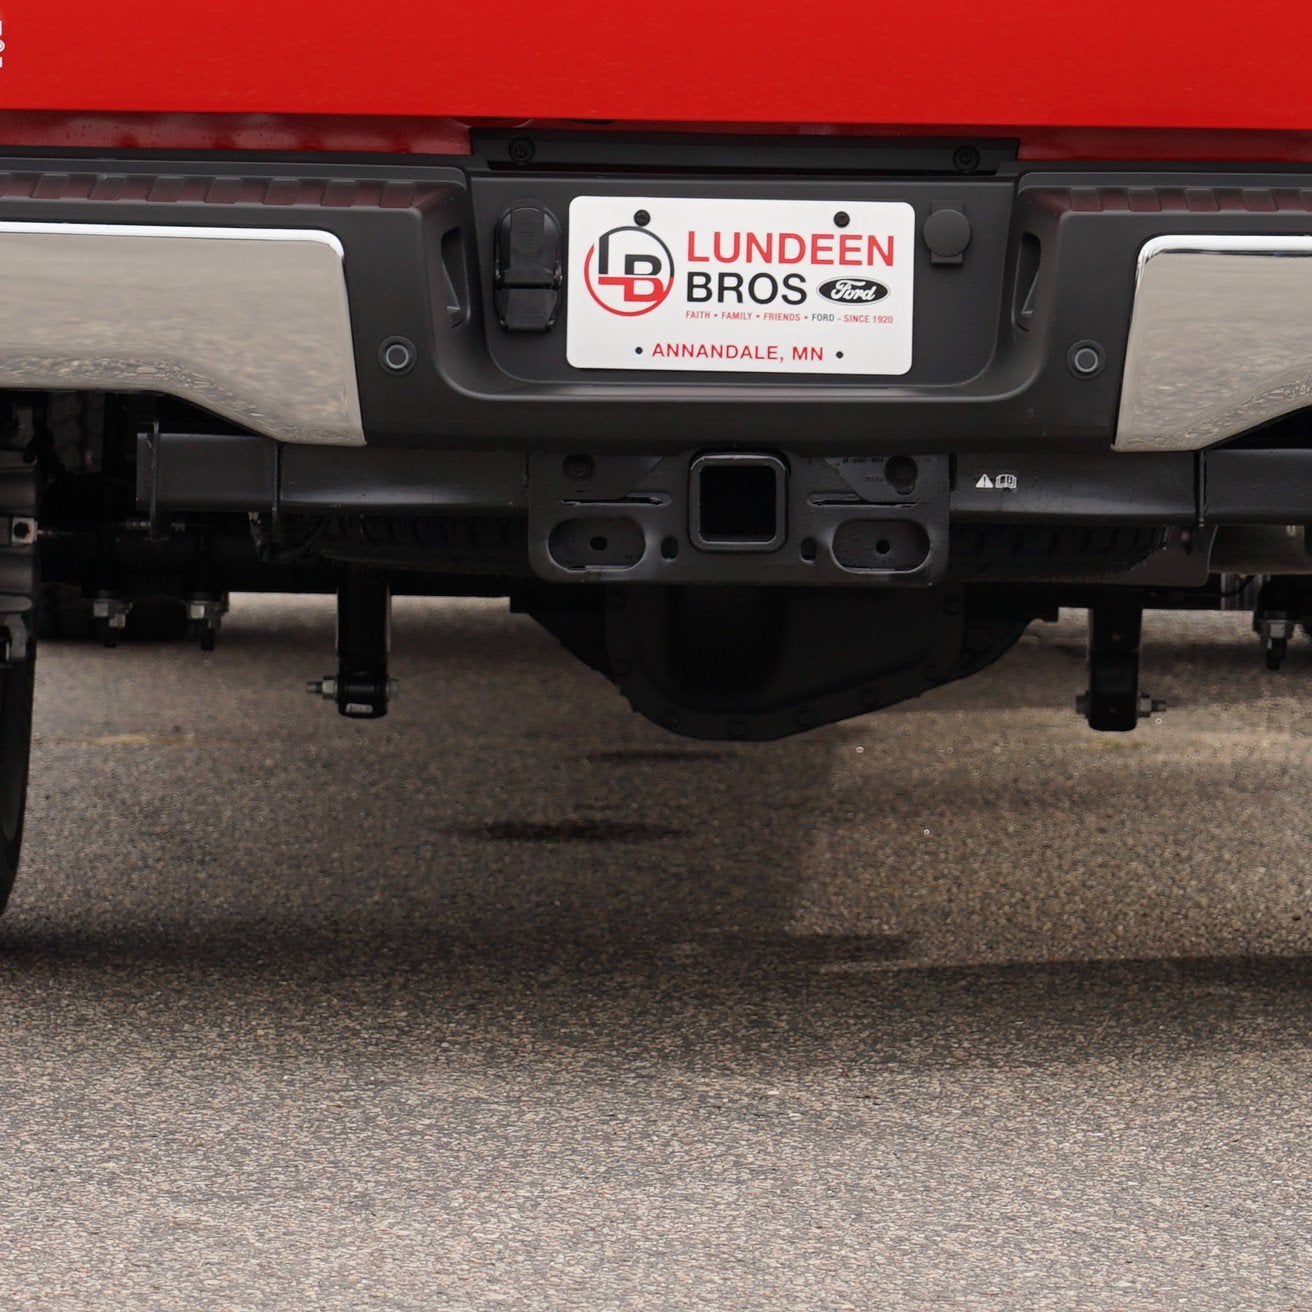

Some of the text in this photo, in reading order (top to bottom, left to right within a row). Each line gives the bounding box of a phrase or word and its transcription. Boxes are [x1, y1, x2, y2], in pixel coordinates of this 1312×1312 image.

[688, 230, 895, 267] LUNDEEN
[687, 271, 807, 306] BROS
[829, 278, 877, 302] Ford
[685, 310, 711, 319] FAITH
[721, 311, 752, 320] FAMILY
[763, 312, 801, 322] FRIENDS
[811, 313, 835, 322] FORD
[843, 314, 870, 323] SINCE
[652, 342, 824, 363] ANNANDALE, MN
